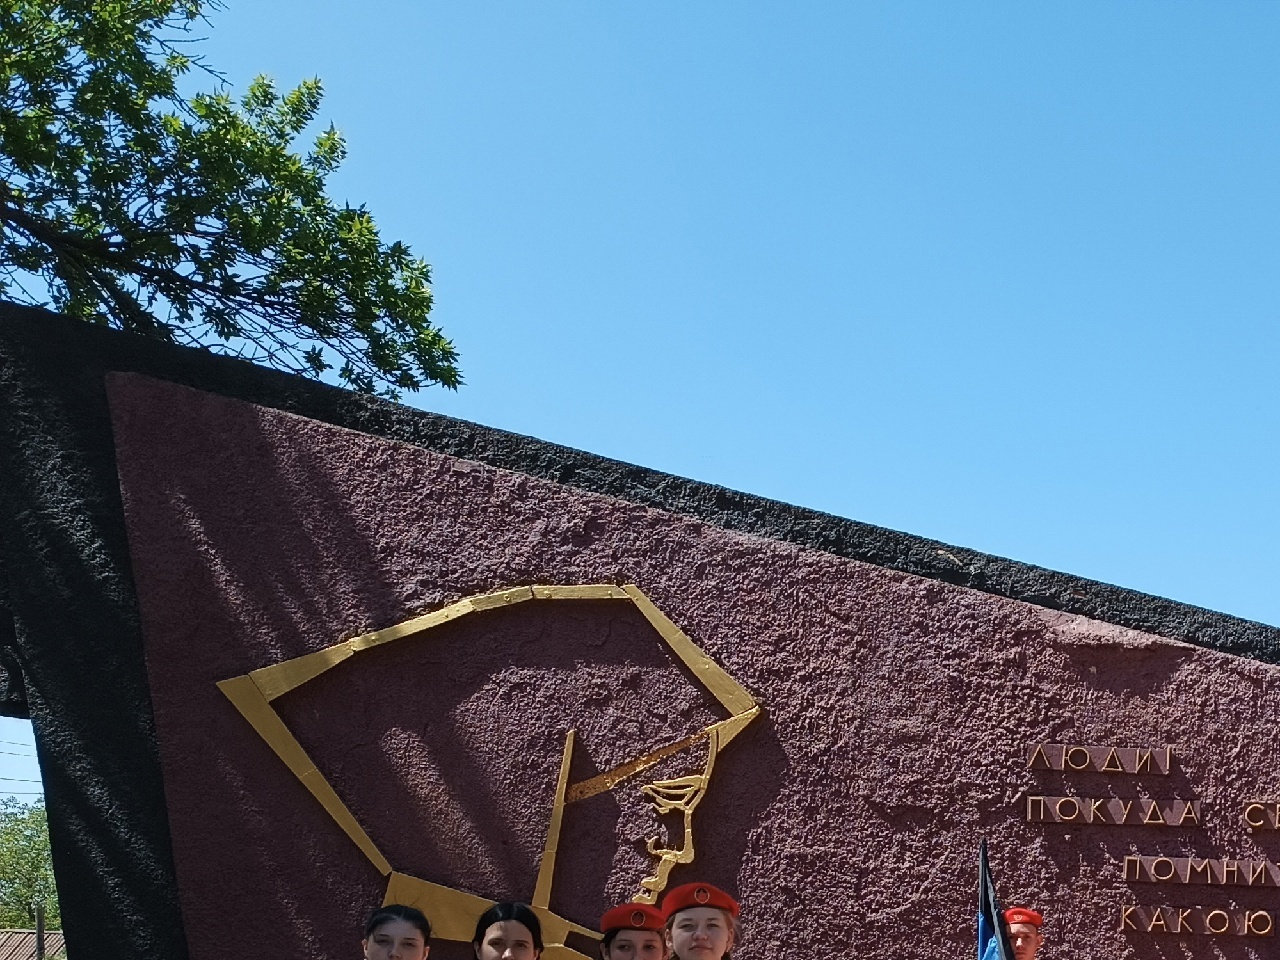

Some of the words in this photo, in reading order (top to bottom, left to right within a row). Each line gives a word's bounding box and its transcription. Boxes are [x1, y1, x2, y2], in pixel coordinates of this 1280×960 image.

[1027, 744, 1172, 775] ЛЮДИ!
[1026, 797, 1199, 825] ПОКУДА
[1120, 905, 1272, 935] КАКОЮ
